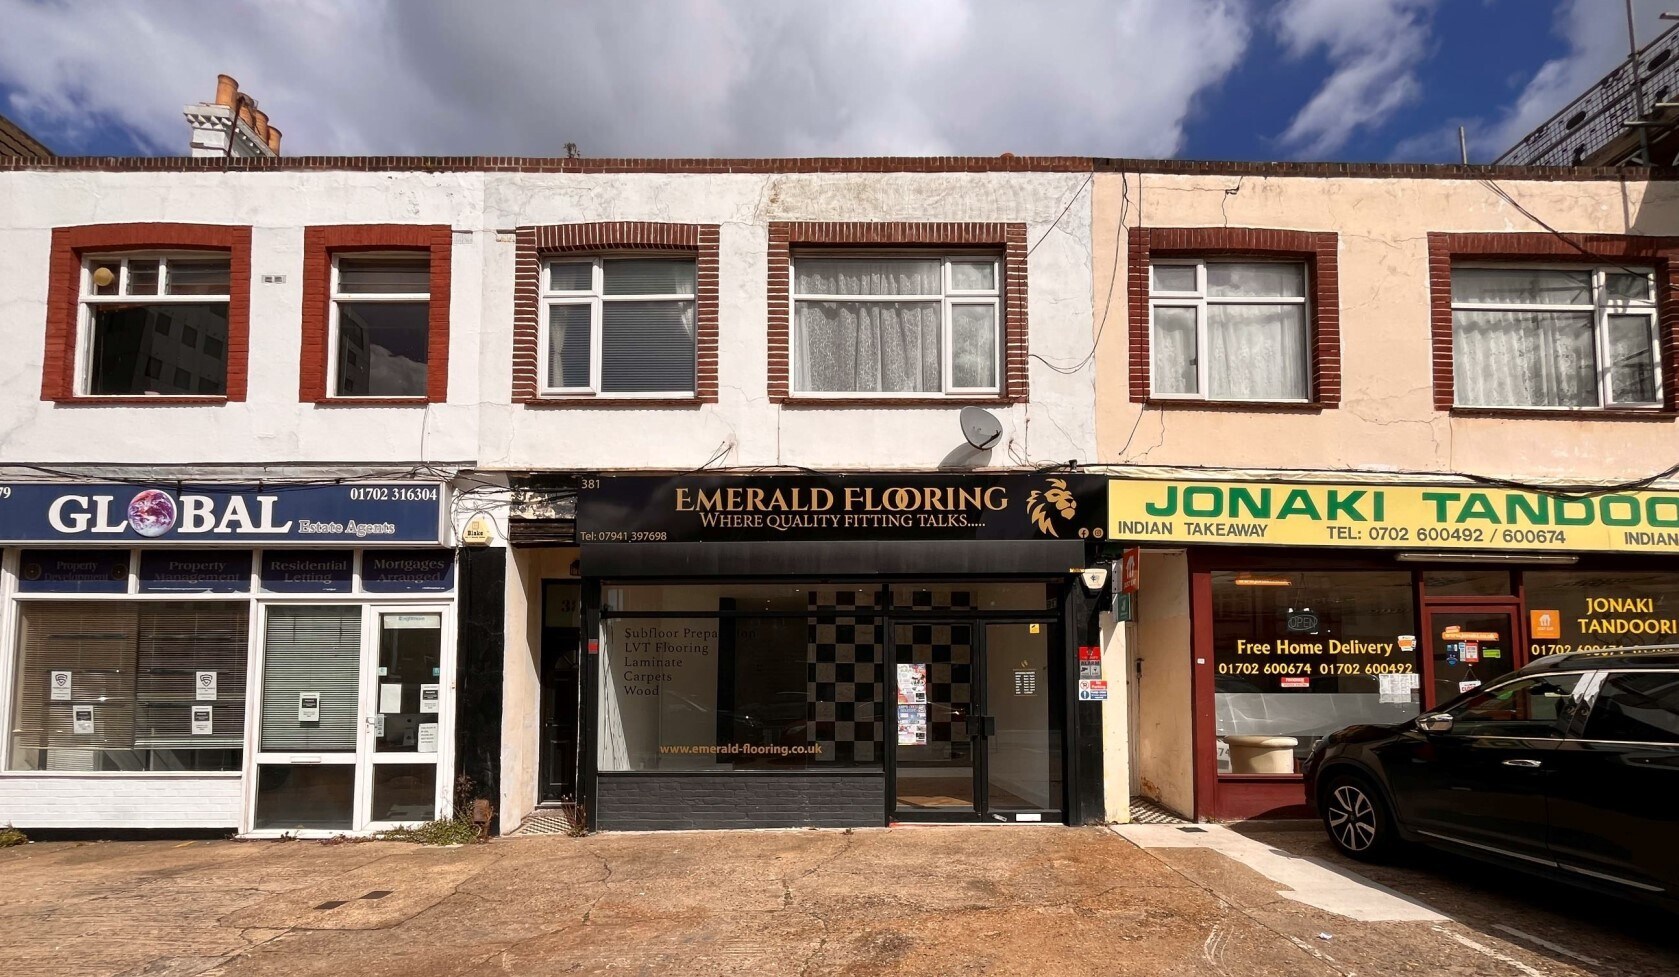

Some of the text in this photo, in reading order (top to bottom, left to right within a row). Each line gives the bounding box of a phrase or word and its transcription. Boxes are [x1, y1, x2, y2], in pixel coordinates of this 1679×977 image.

[581, 479, 601, 489] 381
[350, 487, 438, 501] 01702 316304
[675, 486, 1009, 511] EMERALD FLOORING
[1145, 486, 1385, 522] JONAKI
[298, 519, 396, 537] Estate Agents
[766, 513, 841, 531] QUALITY
[844, 513, 913, 527] FITTING
[1118, 521, 1268, 538] INDIAN TAKEAWAY
[1327, 526, 1362, 540] TEL:
[1368, 527, 1409, 541] 0702
[1416, 528, 1484, 542] 600492
[1502, 529, 1567, 544] 600674
[580, 531, 668, 542] Tel: 07941 397698
[56, 560, 99, 573] Property
[168, 560, 227, 573] Property
[271, 560, 347, 571] Residential
[373, 559, 445, 572] Mortgages
[44, 573, 109, 584] Development
[153, 573, 240, 584] Management
[284, 571, 333, 584] Letting
[377, 571, 441, 584] Arranged
[1586, 597, 1654, 615] JONAKI
[1290, 616, 1316, 628] OPEN
[1577, 618, 1678, 634] TANDOORI
[624, 627, 679, 639] Subfloor
[625, 642, 709, 656] LVT Flooring
[1237, 639, 1393, 657] Free Home Delivery
[1531, 645, 1572, 656] 01702
[624, 656, 683, 668] Laminate
[1218, 663, 1413, 675] 01702 600674 01702 600492
[624, 671, 672, 684] Carpets
[624, 685, 660, 696] Wood
[660, 743, 823, 757] www.emerald-flooring.co.uk
